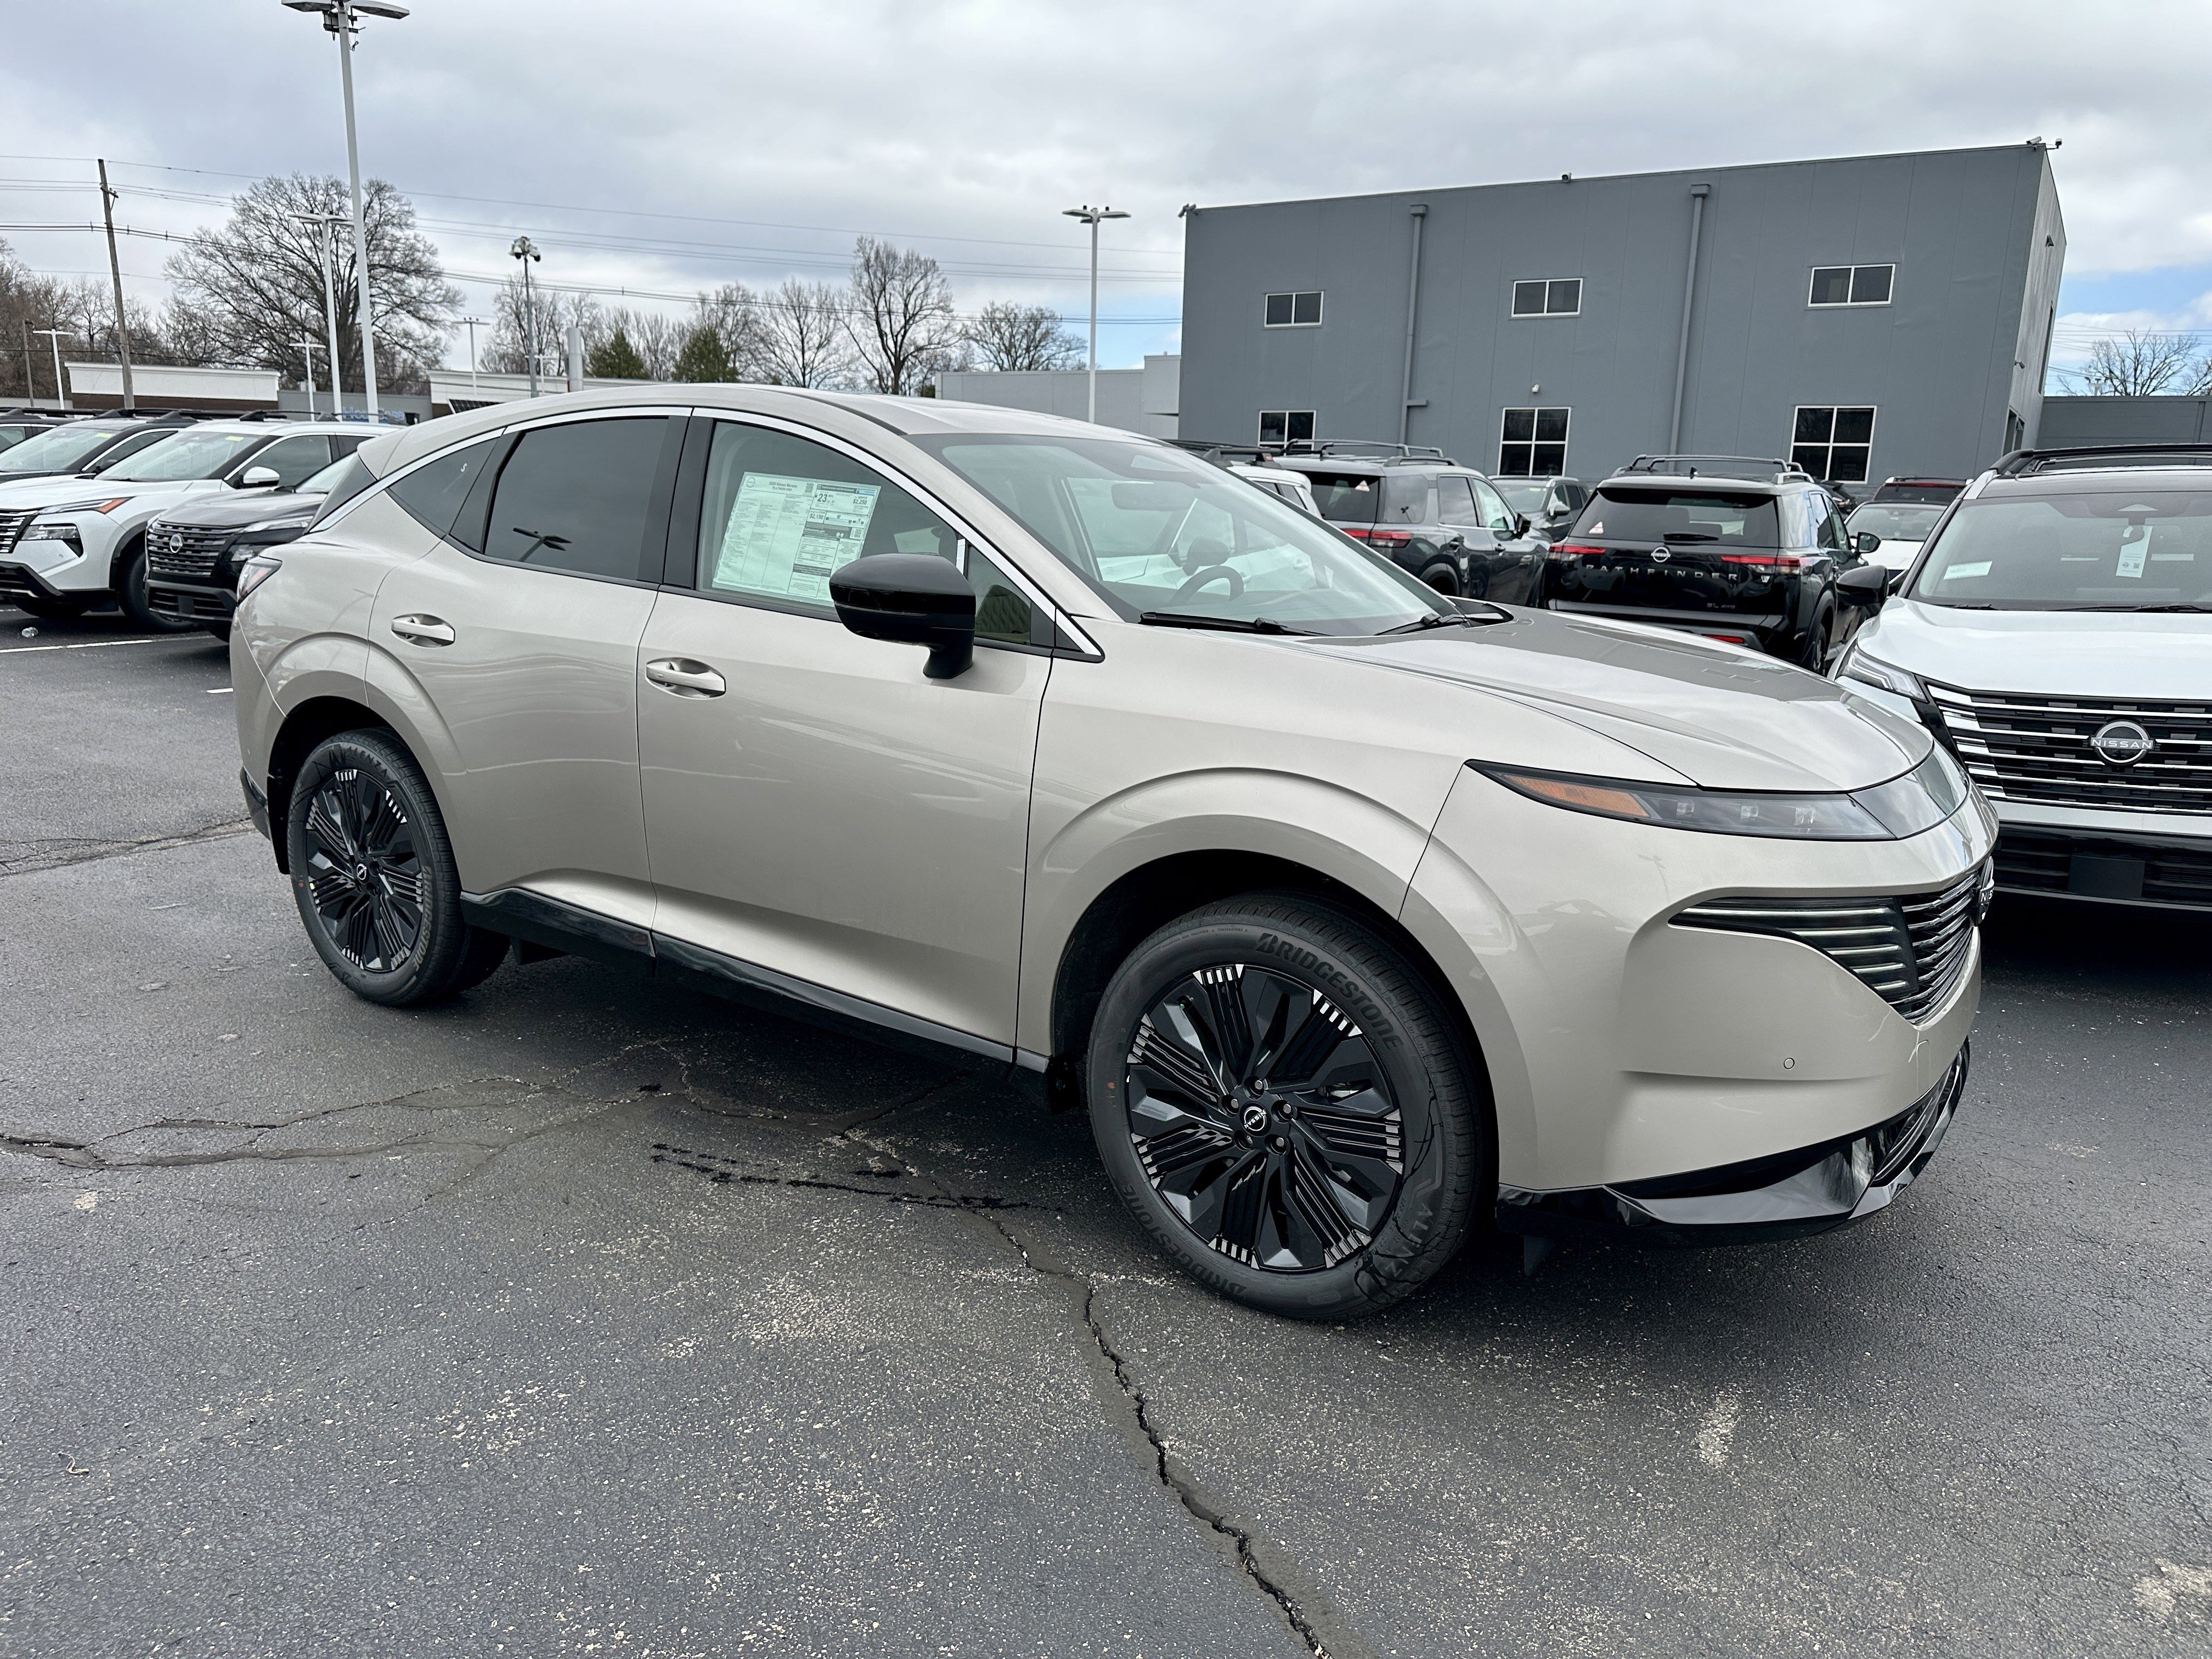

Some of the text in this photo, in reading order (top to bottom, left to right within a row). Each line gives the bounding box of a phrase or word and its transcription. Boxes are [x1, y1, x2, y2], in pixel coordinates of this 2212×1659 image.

[817, 494, 827, 503] 23
[1586, 565, 1737, 581] PATHFINDER
[2091, 739, 2151, 748] NISSAN
[413, 865, 433, 971] BRIDGESTONE
[1255, 932, 1404, 1051] BRIDGESTONE
[1244, 1109, 1267, 1129] NISSAN
[1121, 1184, 1248, 1295] BRIDGESTONE
